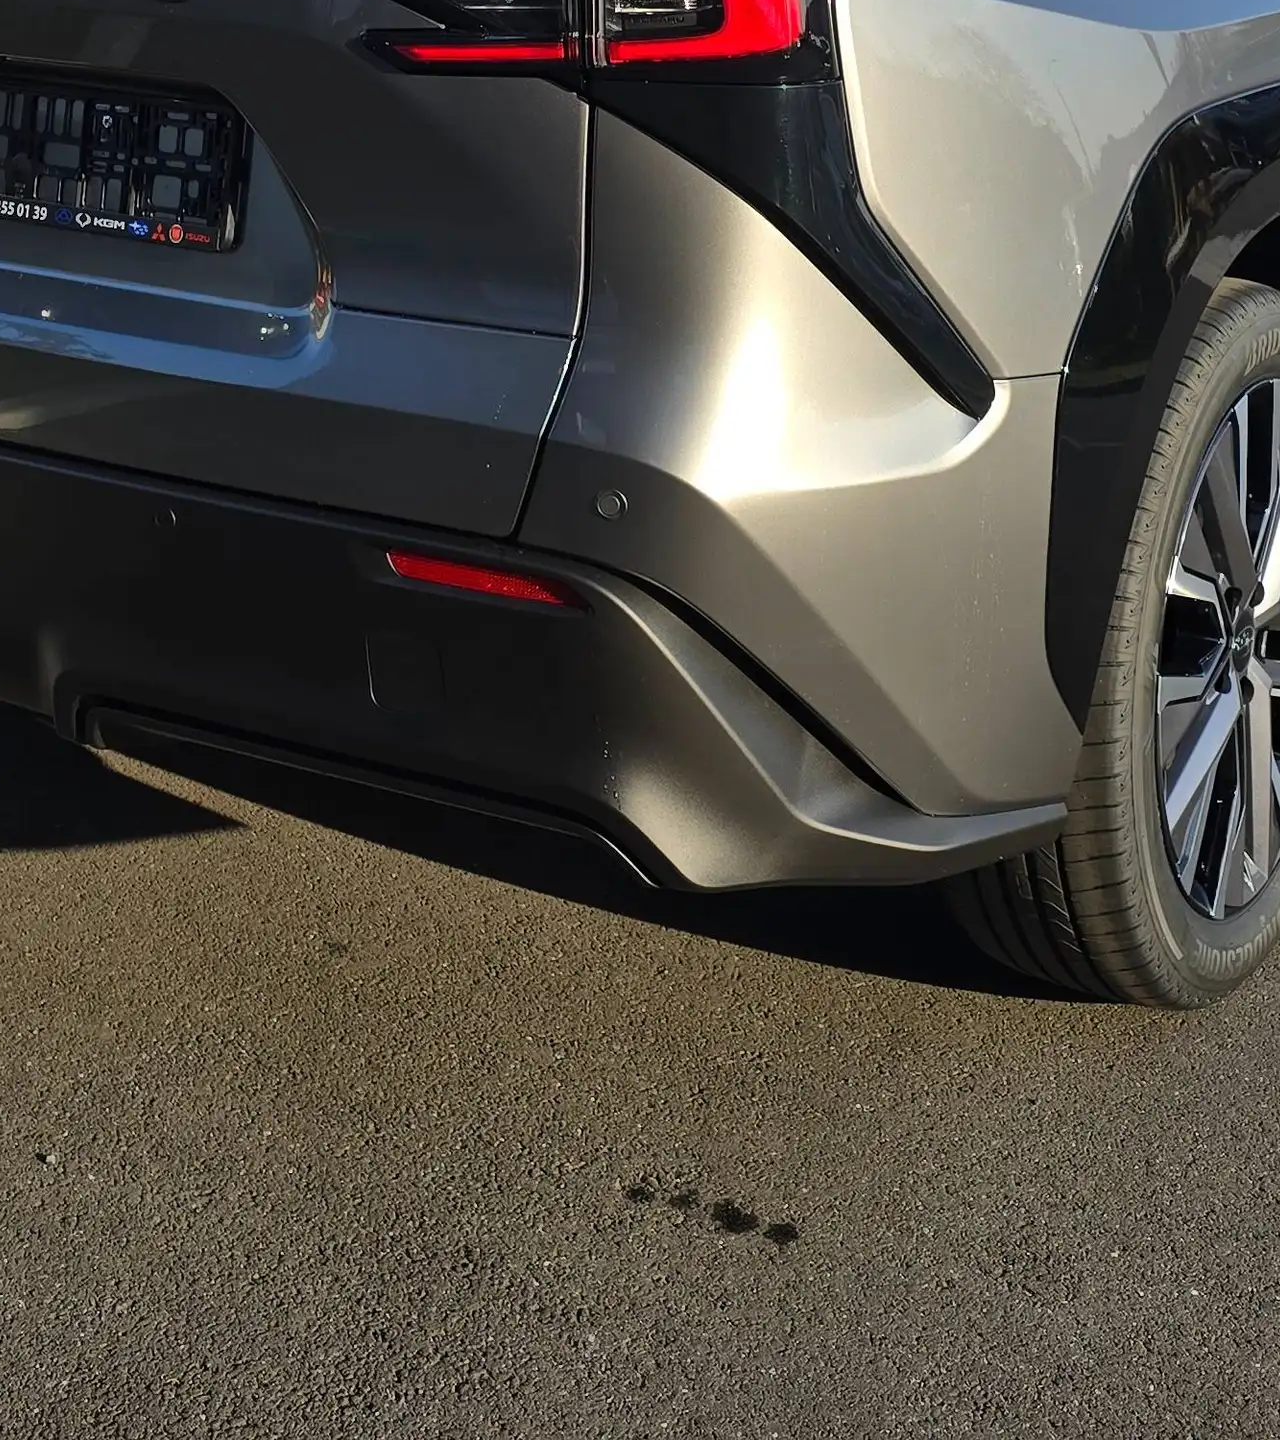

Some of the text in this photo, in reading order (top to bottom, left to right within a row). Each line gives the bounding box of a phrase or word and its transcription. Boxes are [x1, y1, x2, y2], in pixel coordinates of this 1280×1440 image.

[16, 203, 30, 219] 01
[32, 205, 48, 221] 39
[93, 216, 126, 230] KGM
[184, 232, 211, 243] ISUZU
